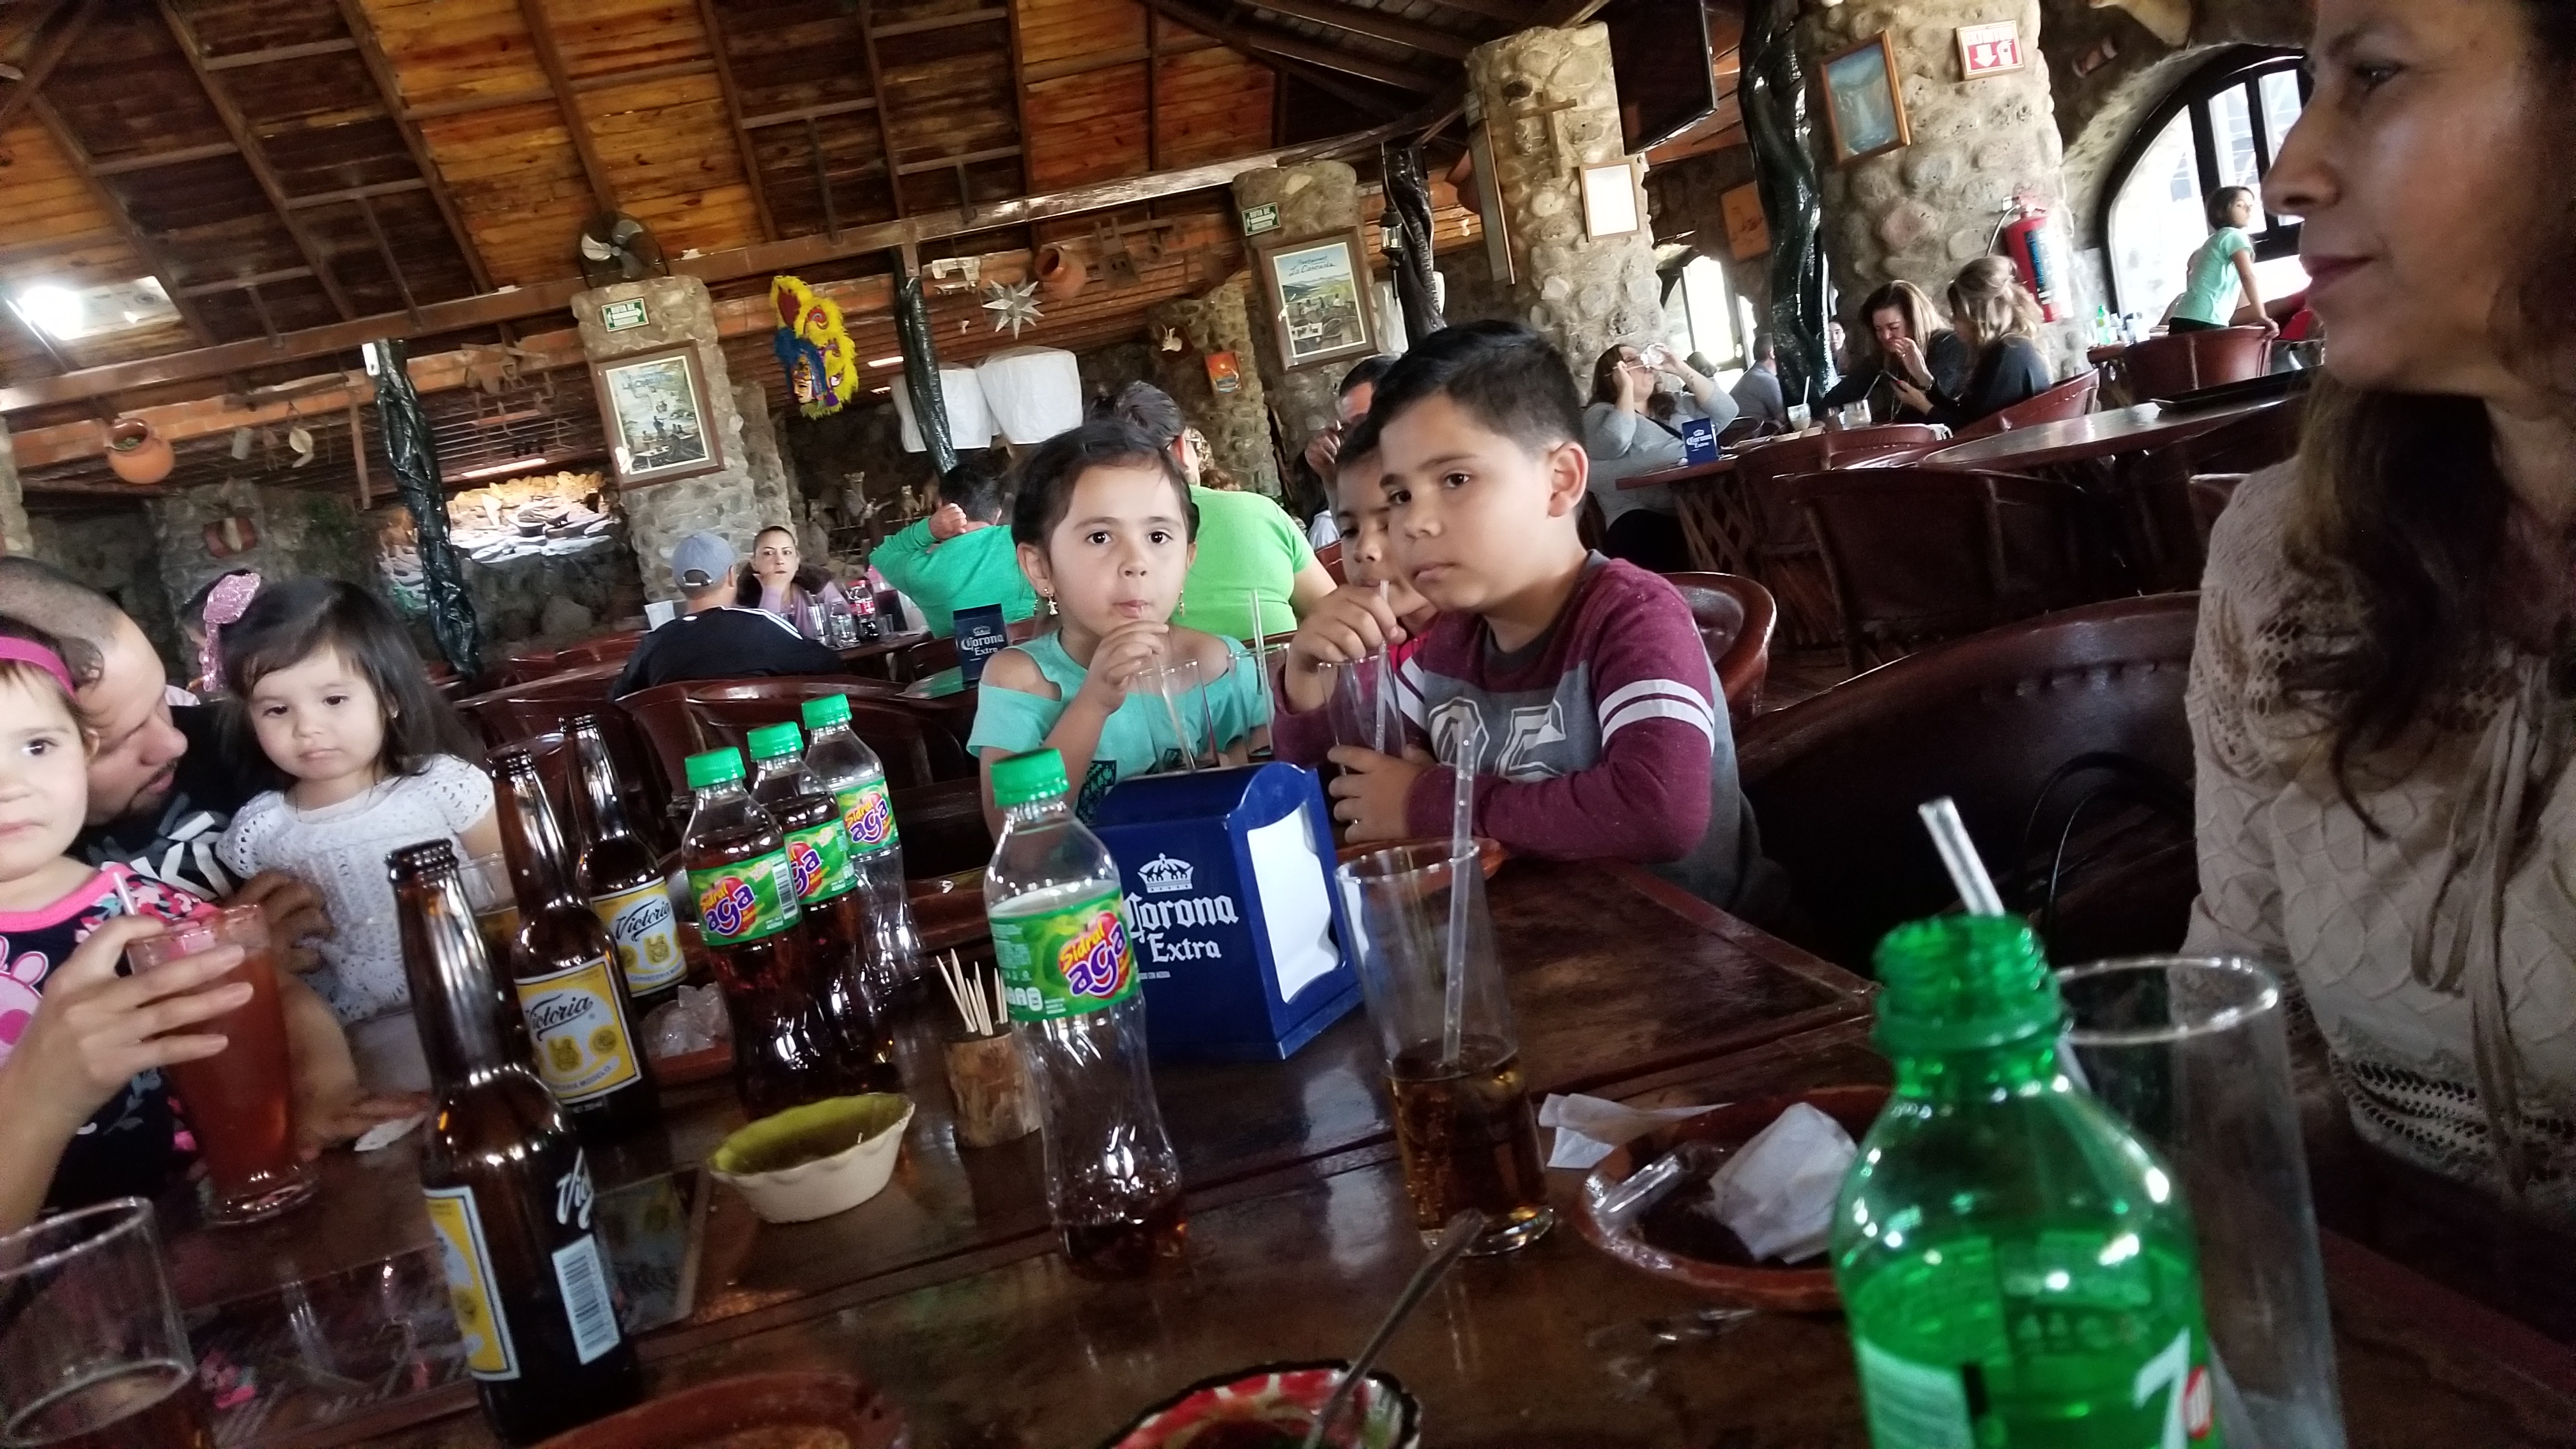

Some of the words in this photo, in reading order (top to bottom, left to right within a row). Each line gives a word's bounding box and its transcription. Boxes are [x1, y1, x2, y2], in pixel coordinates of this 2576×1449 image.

[961, 634, 1004, 650] Corona
[845, 796, 874, 828] Sidral
[615, 898, 670, 942] Victoria
[1123, 892, 1239, 944] Corona
[1059, 920, 1105, 972] Sidral
[1147, 932, 1222, 963] Extra
